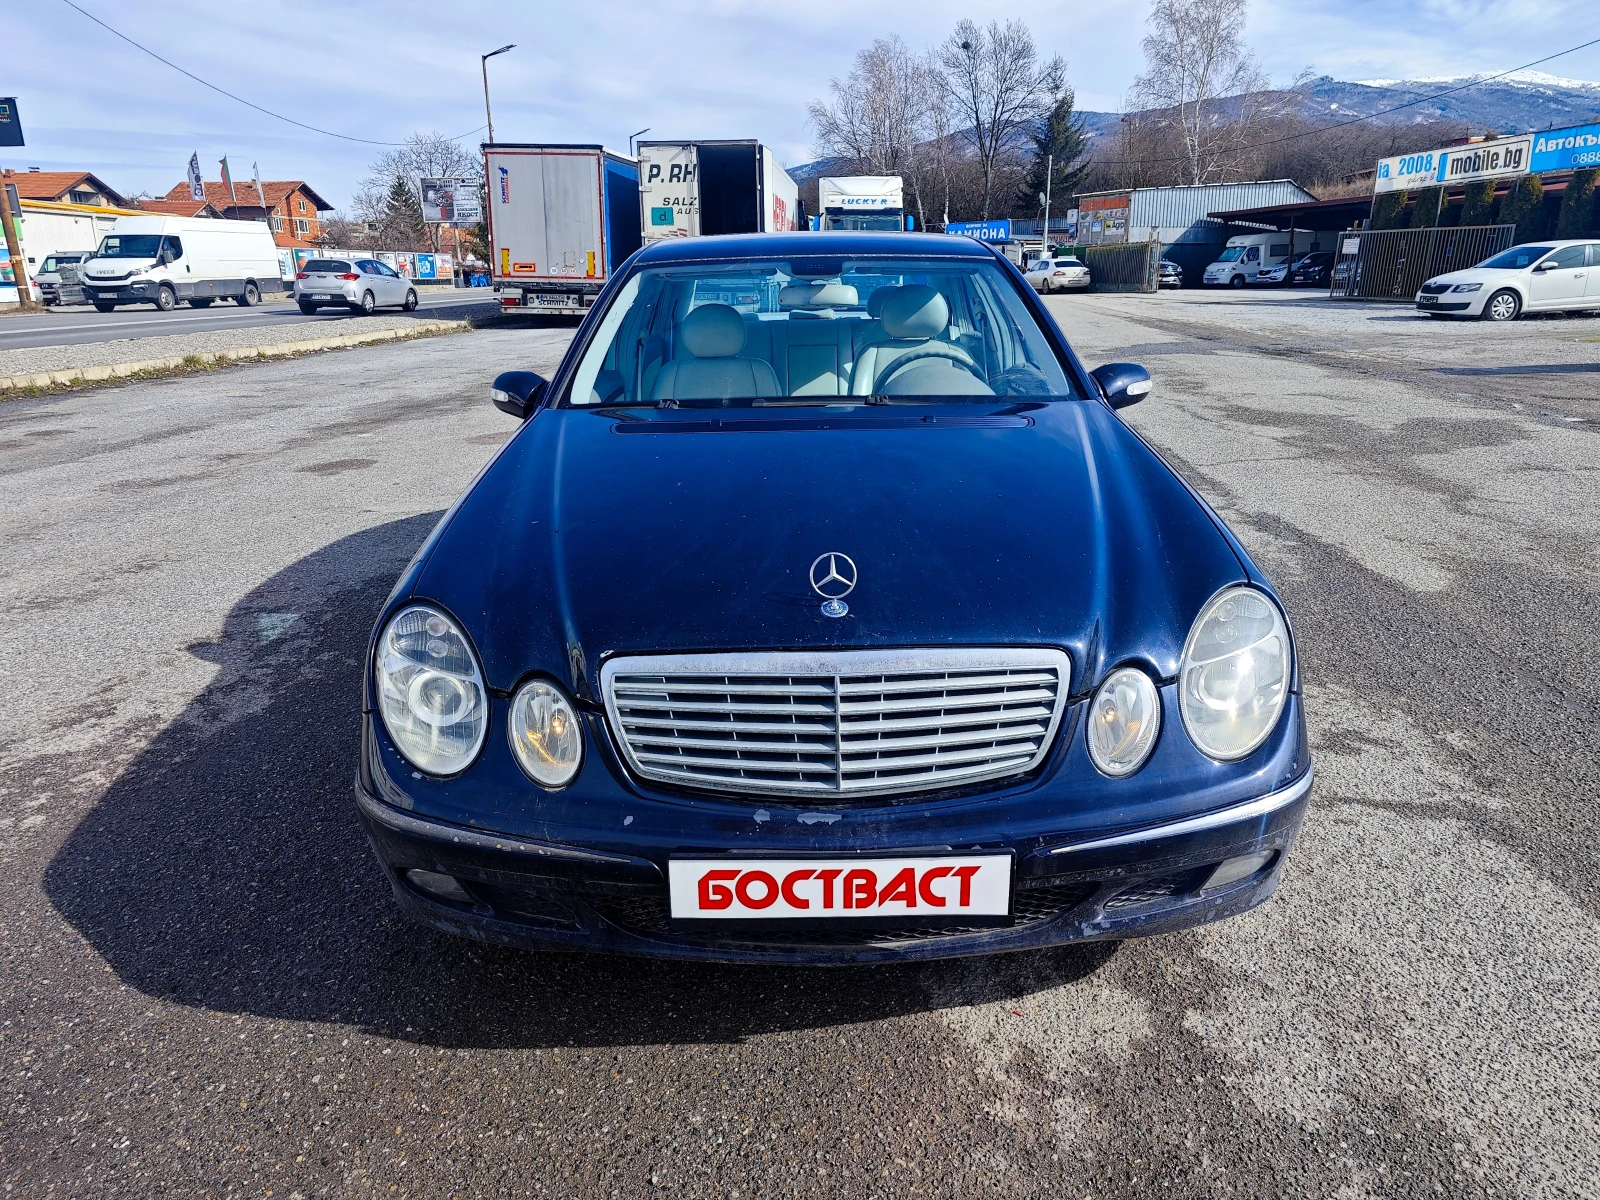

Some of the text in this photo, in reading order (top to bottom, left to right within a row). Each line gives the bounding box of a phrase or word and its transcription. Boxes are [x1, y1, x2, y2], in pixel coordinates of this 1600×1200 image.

[1535, 133, 1600, 154] Автокъ
[1450, 146, 1524, 175] mobile.bg
[663, 197, 698, 206] SALZ
[1081, 197, 1128, 211] СЕРВИЗ
[659, 211, 667, 221] d
